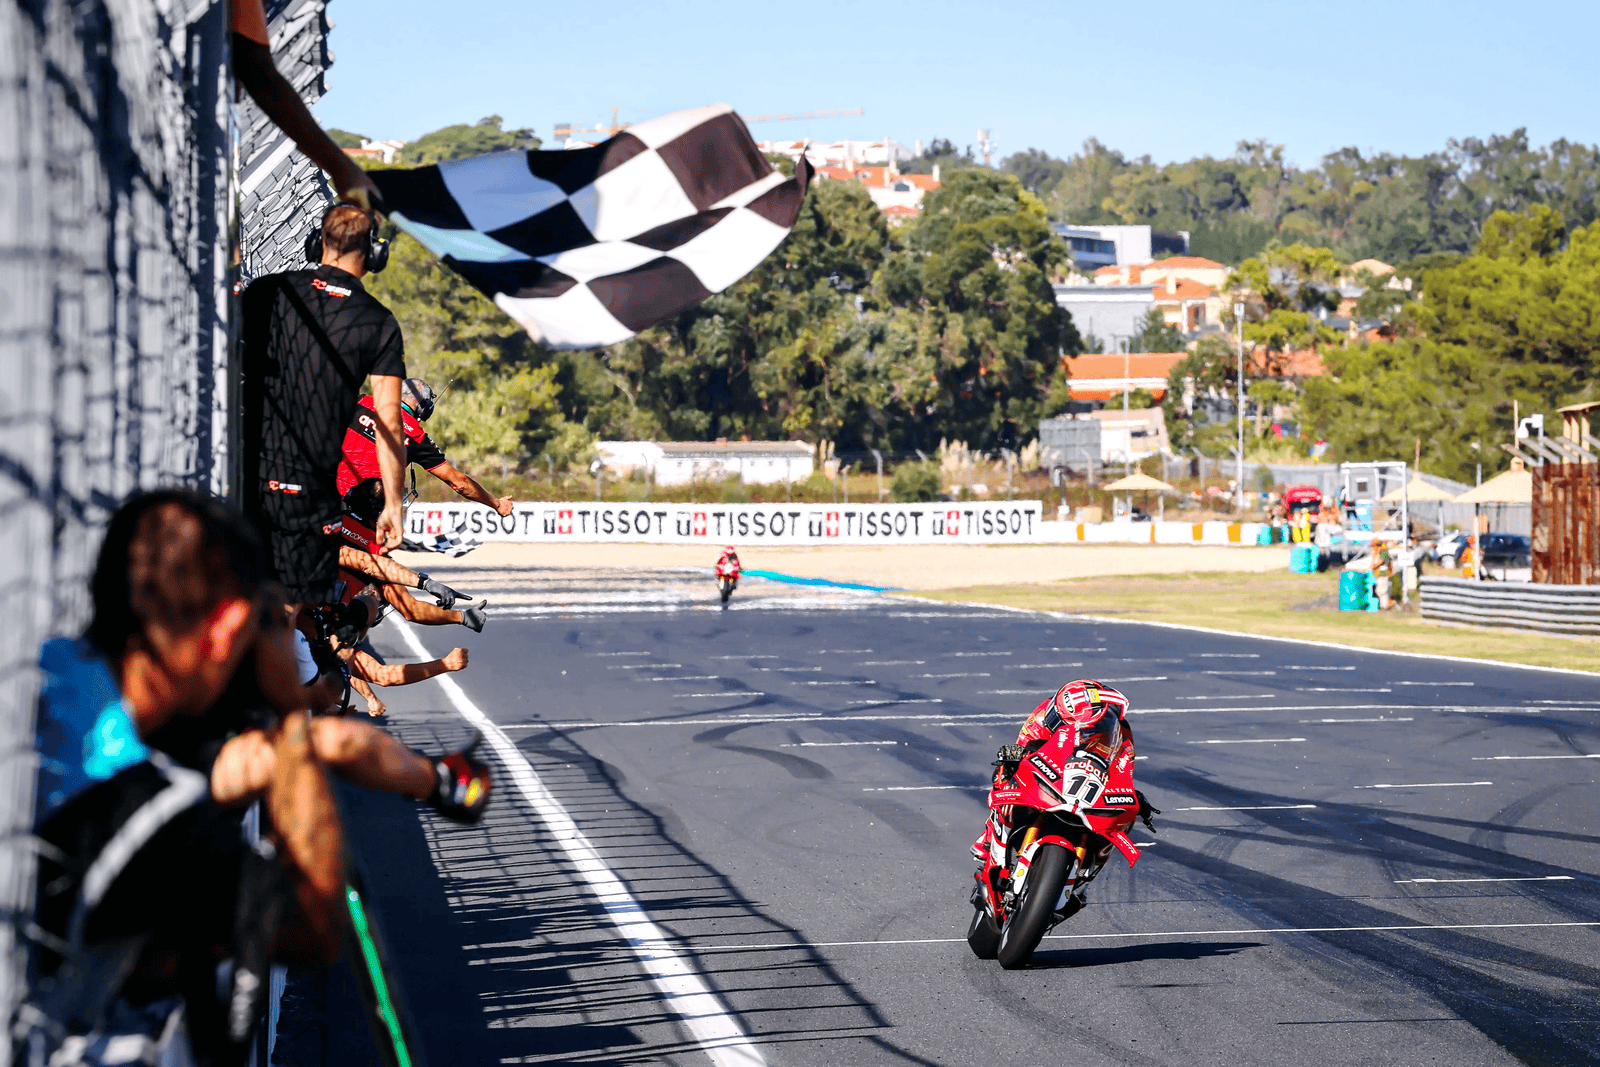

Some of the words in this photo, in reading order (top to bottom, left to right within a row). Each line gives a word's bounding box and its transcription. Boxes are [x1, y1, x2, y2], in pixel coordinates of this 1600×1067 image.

[577, 510, 668, 535] TISSOT
[712, 511, 801, 537] TISSOT
[844, 511, 924, 537] TISSOT
[963, 509, 1036, 535] TISSOT
[1030, 756, 1057, 780] Lenovo
[1064, 759, 1109, 785] aruba.it
[1066, 775, 1101, 804] 11
[1104, 795, 1134, 804] Lenovo
